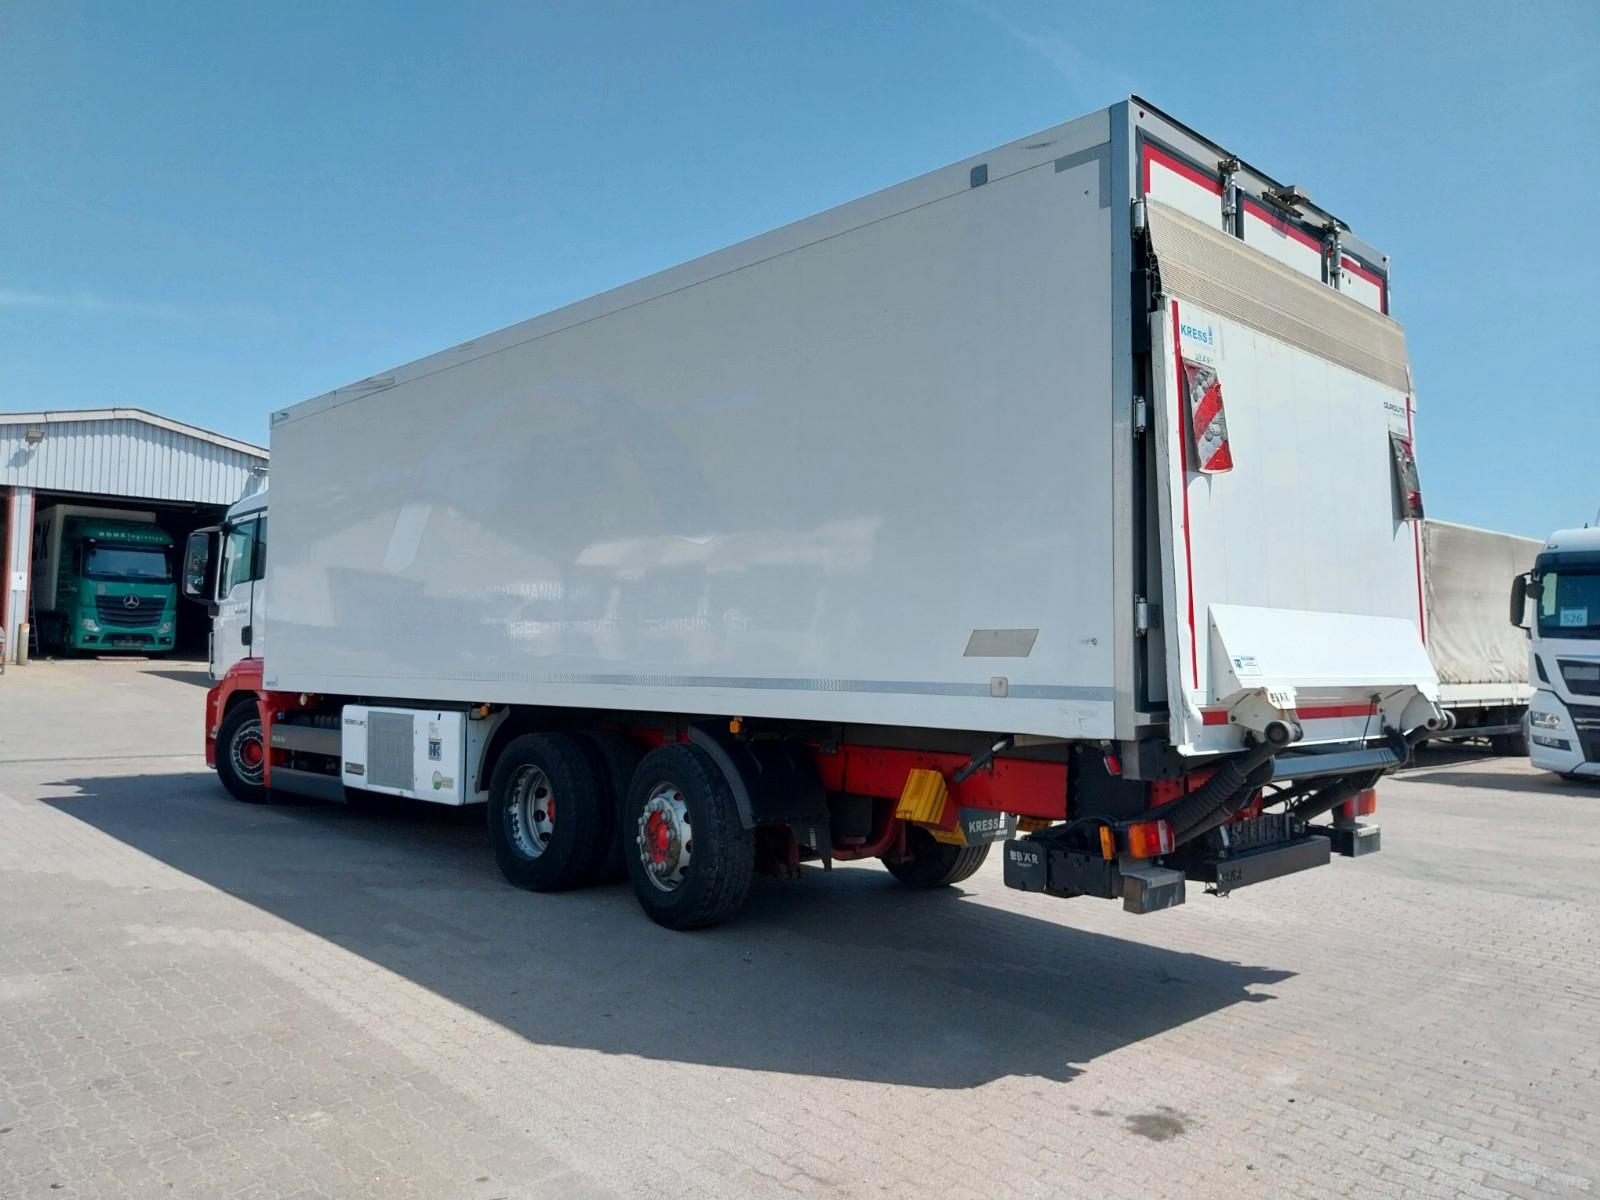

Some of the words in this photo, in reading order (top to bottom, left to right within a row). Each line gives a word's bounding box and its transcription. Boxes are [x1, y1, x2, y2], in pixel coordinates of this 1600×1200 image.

[1181, 324, 1208, 343] KRESS
[1564, 614, 1584, 624] 526
[969, 818, 999, 833] KRESS
